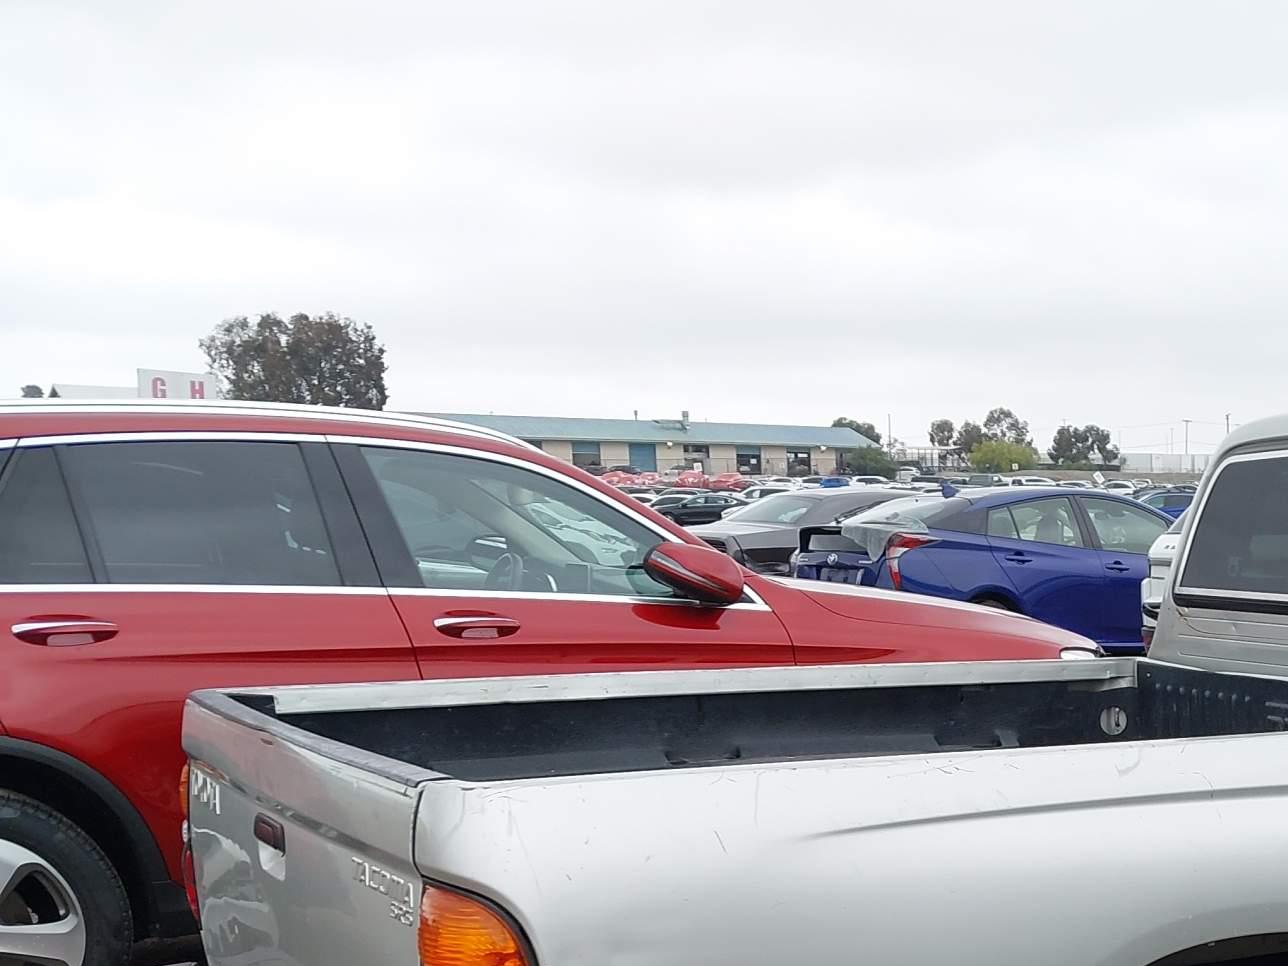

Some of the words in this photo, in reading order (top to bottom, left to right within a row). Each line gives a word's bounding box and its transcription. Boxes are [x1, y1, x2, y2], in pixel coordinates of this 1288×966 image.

[151, 377, 167, 399] G
[189, 380, 205, 399] H
[351, 856, 414, 908] TACOMA
